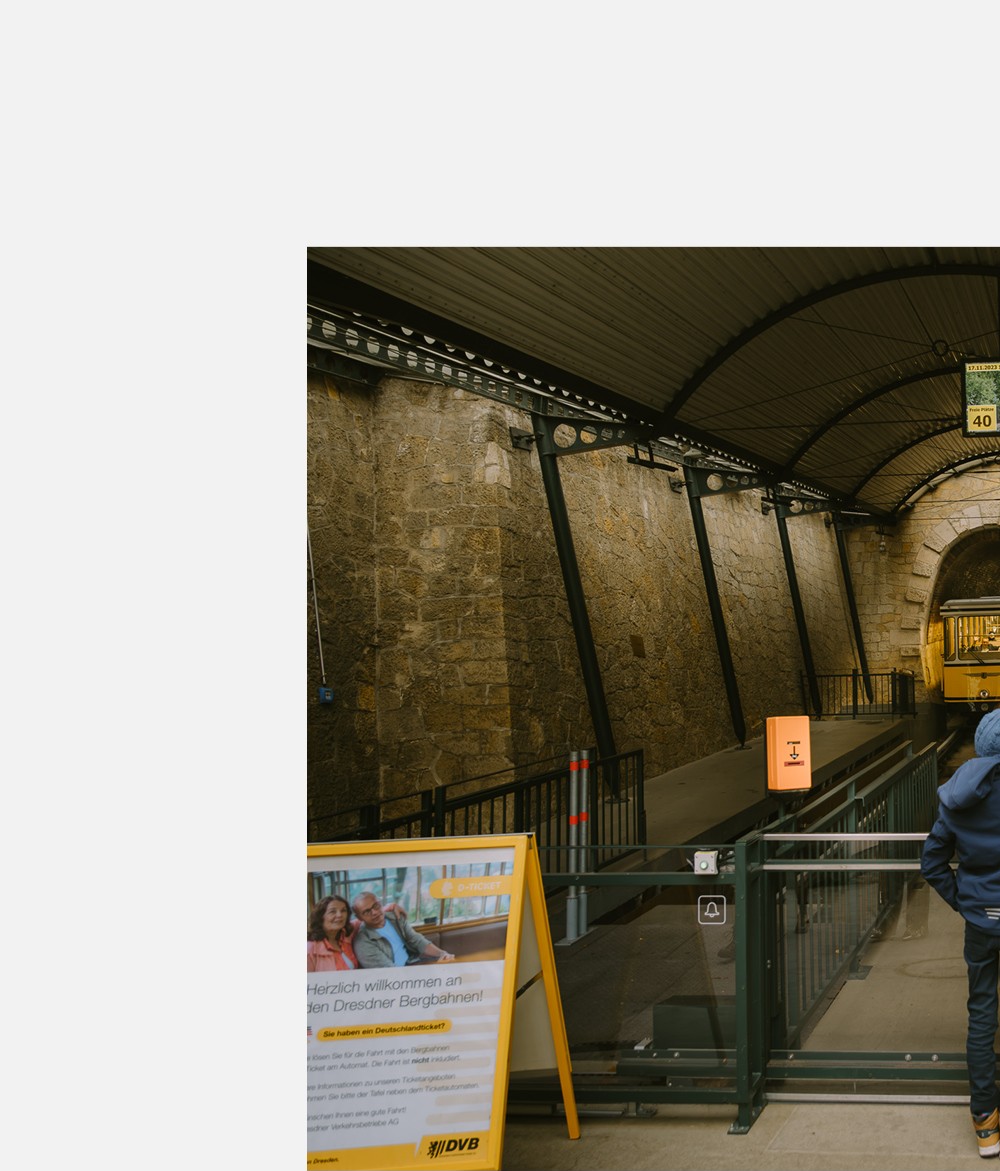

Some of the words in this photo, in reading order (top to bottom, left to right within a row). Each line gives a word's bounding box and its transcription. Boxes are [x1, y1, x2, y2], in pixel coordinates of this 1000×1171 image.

[973, 415, 992, 428] 40
[307, 981, 360, 996] Herzlich
[365, 977, 442, 992] willkommen
[445, 976, 462, 987] an
[307, 1001, 329, 1013] den
[333, 997, 396, 1012] Dresdner
[399, 989, 484, 1009] Bergbahnen!
[323, 1030, 335, 1038] Sie
[337, 1029, 360, 1037] haben
[375, 1021, 446, 1034] Deutschlandticket?
[366, 1049, 383, 1057] Fahrt
[384, 1048, 395, 1056] mit
[396, 1047, 409, 1055] den
[411, 1045, 450, 1055] Bergbahnen
[384, 1059, 401, 1067] Fahrt
[317, 1081, 363, 1090] Informationen
[374, 1078, 400, 1086] unseren
[371, 1089, 386, 1097] Tafel
[409, 1086, 423, 1094] dem
[335, 1111, 354, 1119] Ihnen
[371, 1108, 386, 1117] gute
[388, 1106, 407, 1114] Fahrt!
[331, 1120, 387, 1131] Verkehrsbetriebe
[388, 1118, 399, 1126] AG
[444, 1137, 479, 1152] DVB
